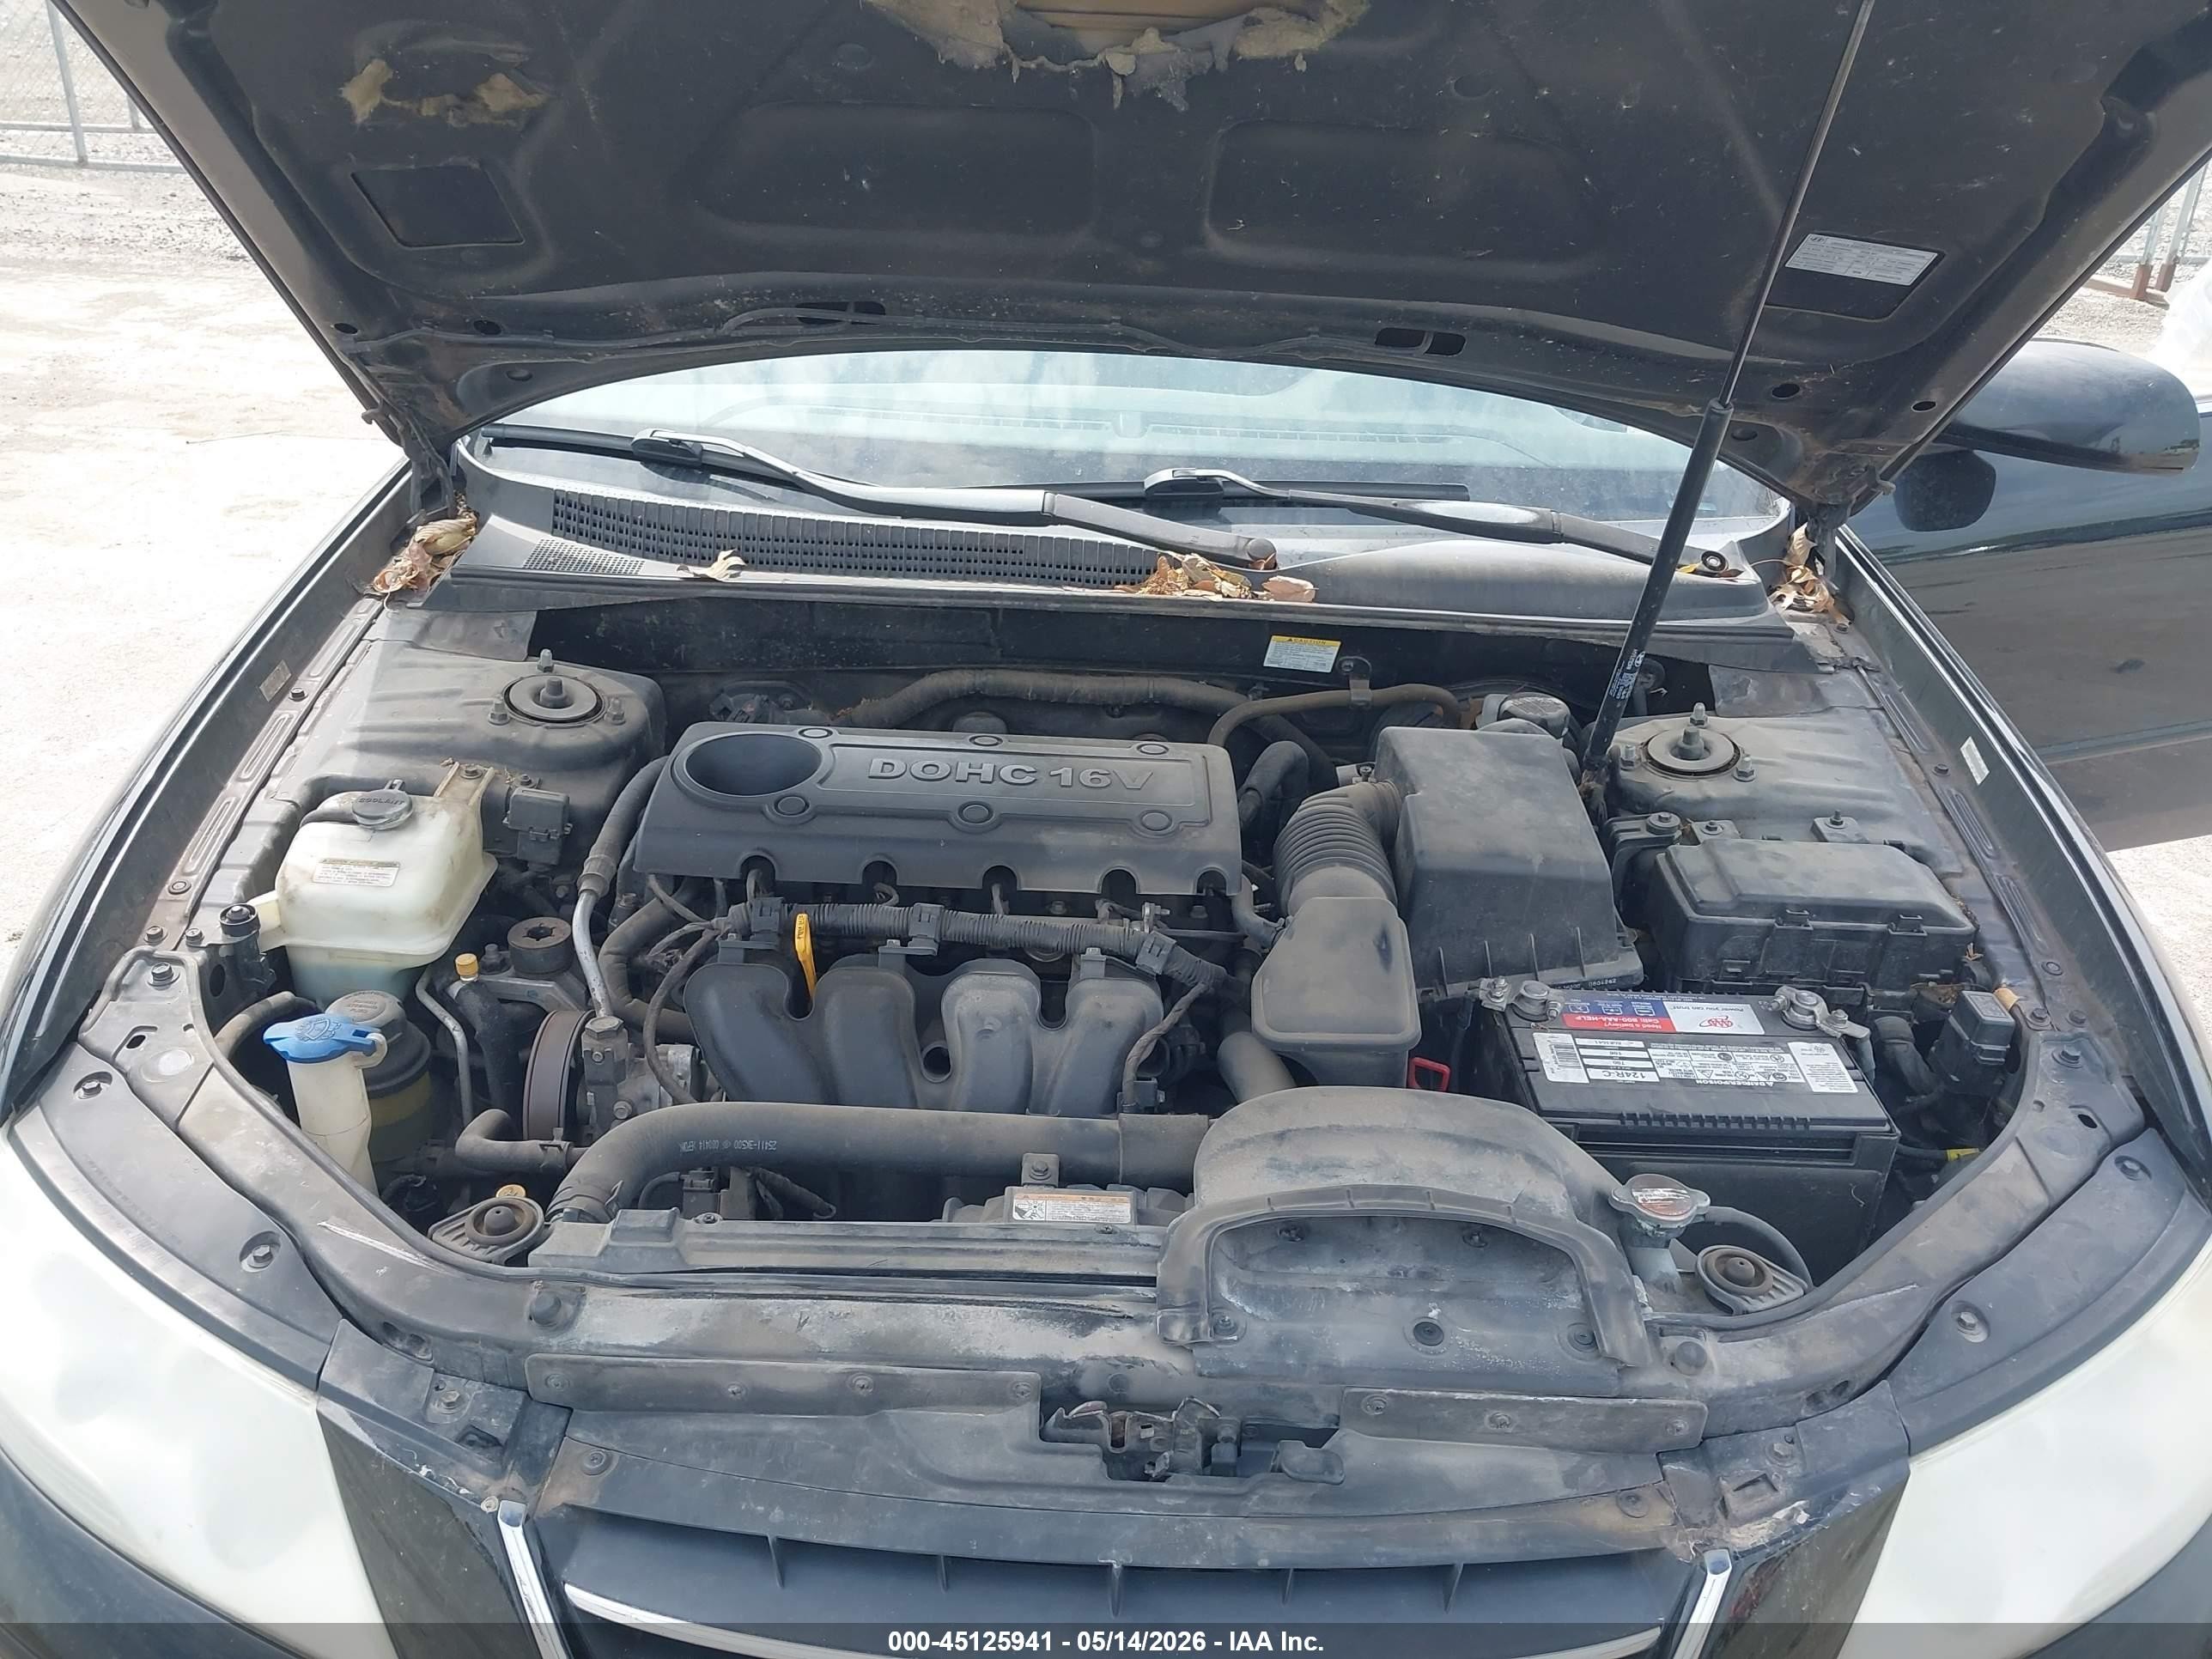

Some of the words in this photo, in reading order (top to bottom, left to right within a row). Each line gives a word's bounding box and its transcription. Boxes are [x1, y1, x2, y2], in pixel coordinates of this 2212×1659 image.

[867, 757, 1037, 786] DOHC
[1048, 766, 1154, 790] 16V
[358, 797, 405, 805] COOLANT
[1601, 1070, 1646, 1079] 124R-C
